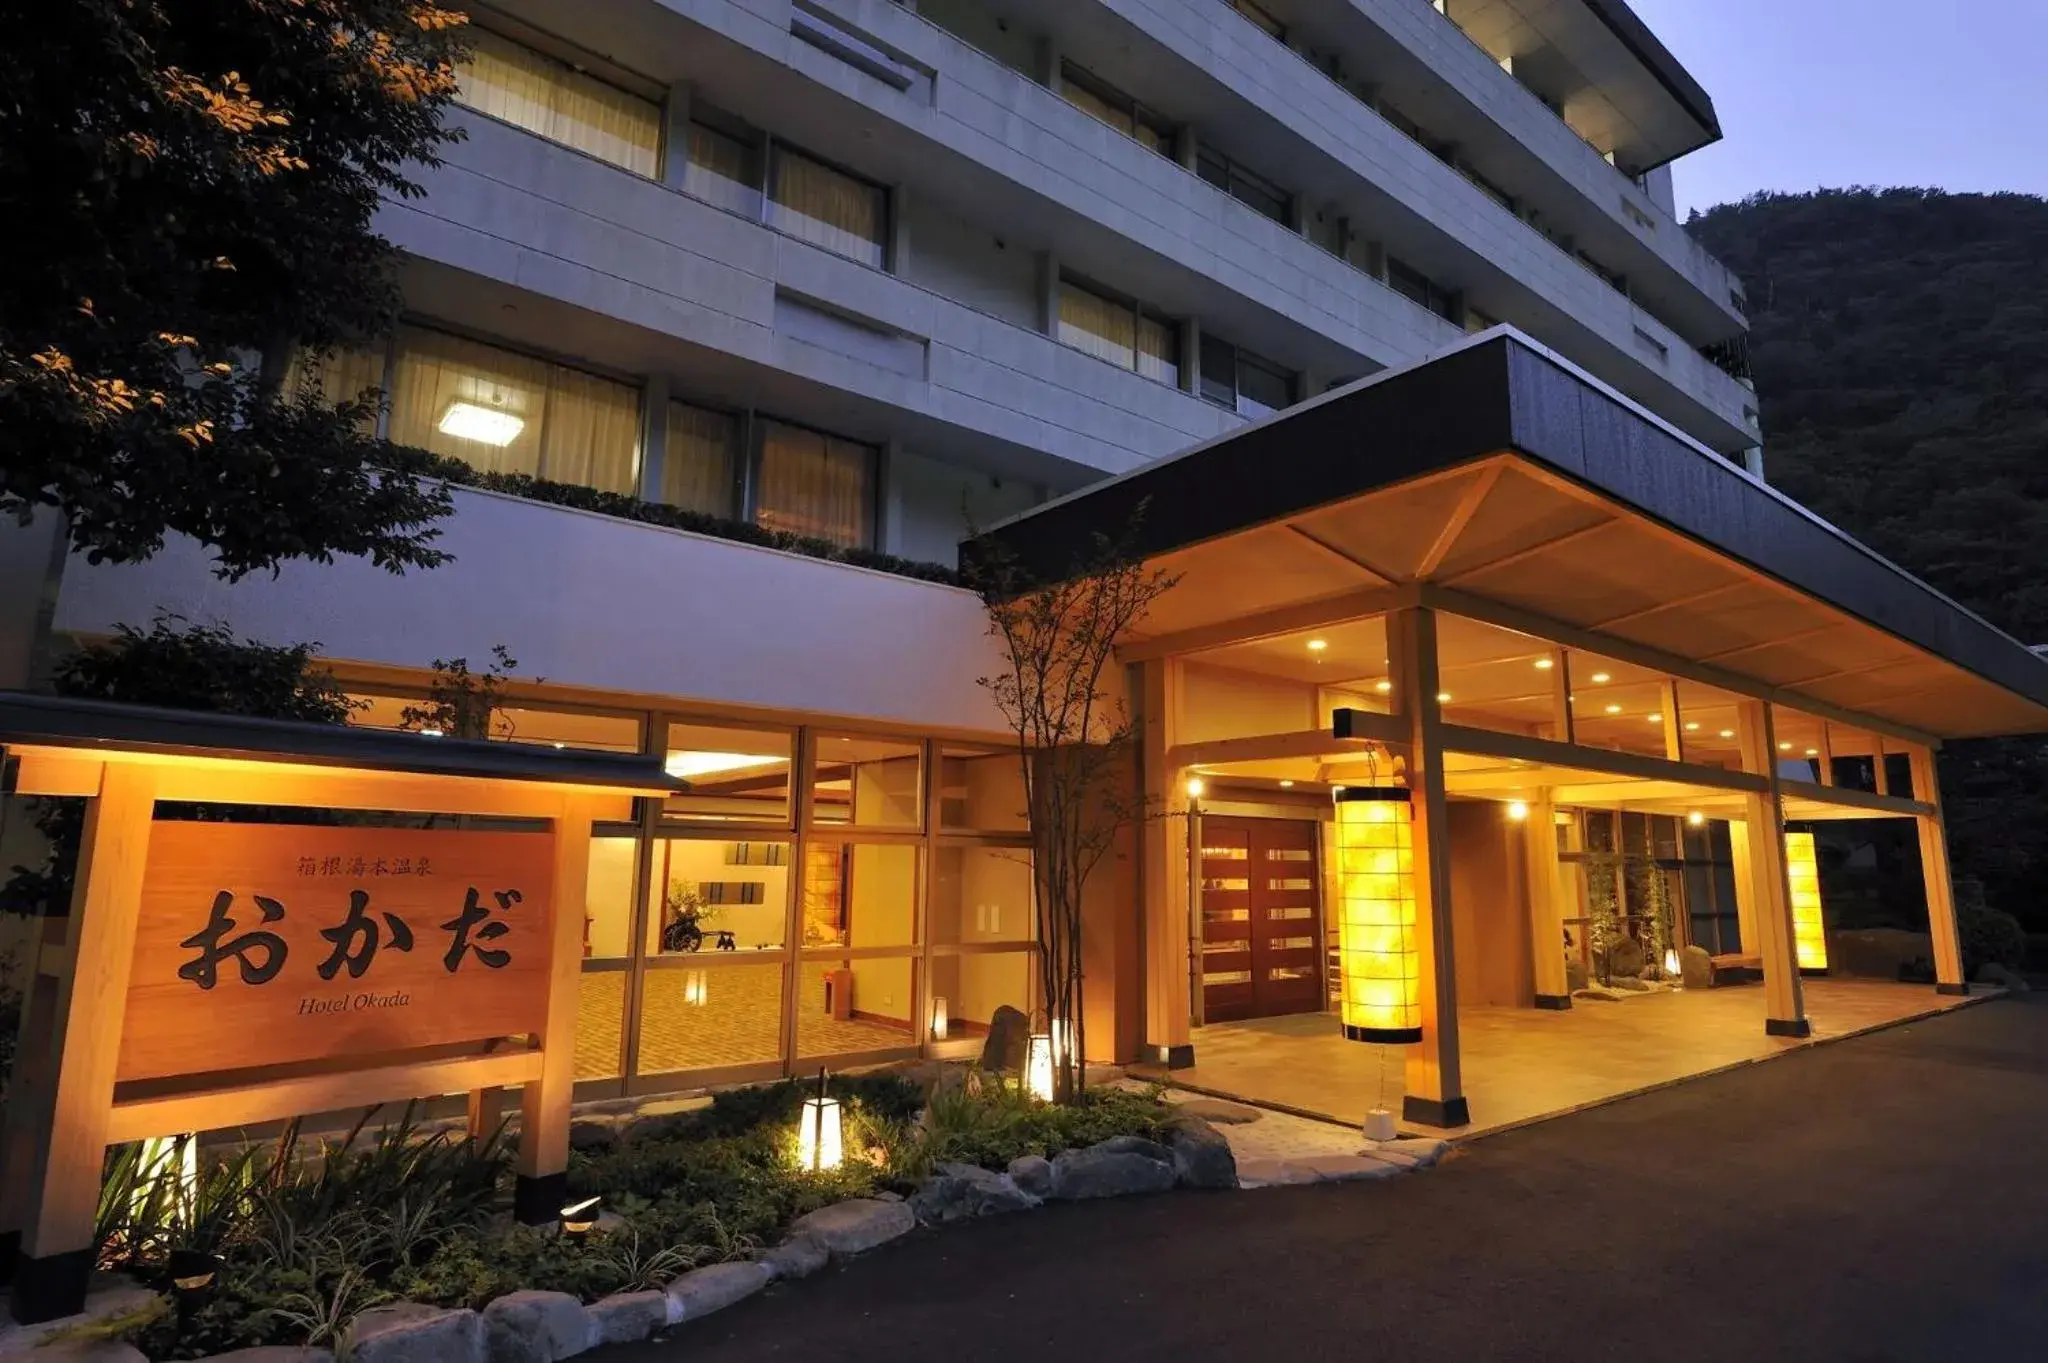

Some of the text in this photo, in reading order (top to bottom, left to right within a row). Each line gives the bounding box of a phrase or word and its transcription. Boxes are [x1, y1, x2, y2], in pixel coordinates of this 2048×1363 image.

[298, 856, 433, 877] 箱根湯本温泉
[177, 884, 523, 990] おかだ
[298, 990, 409, 1016] Hotel Okada
